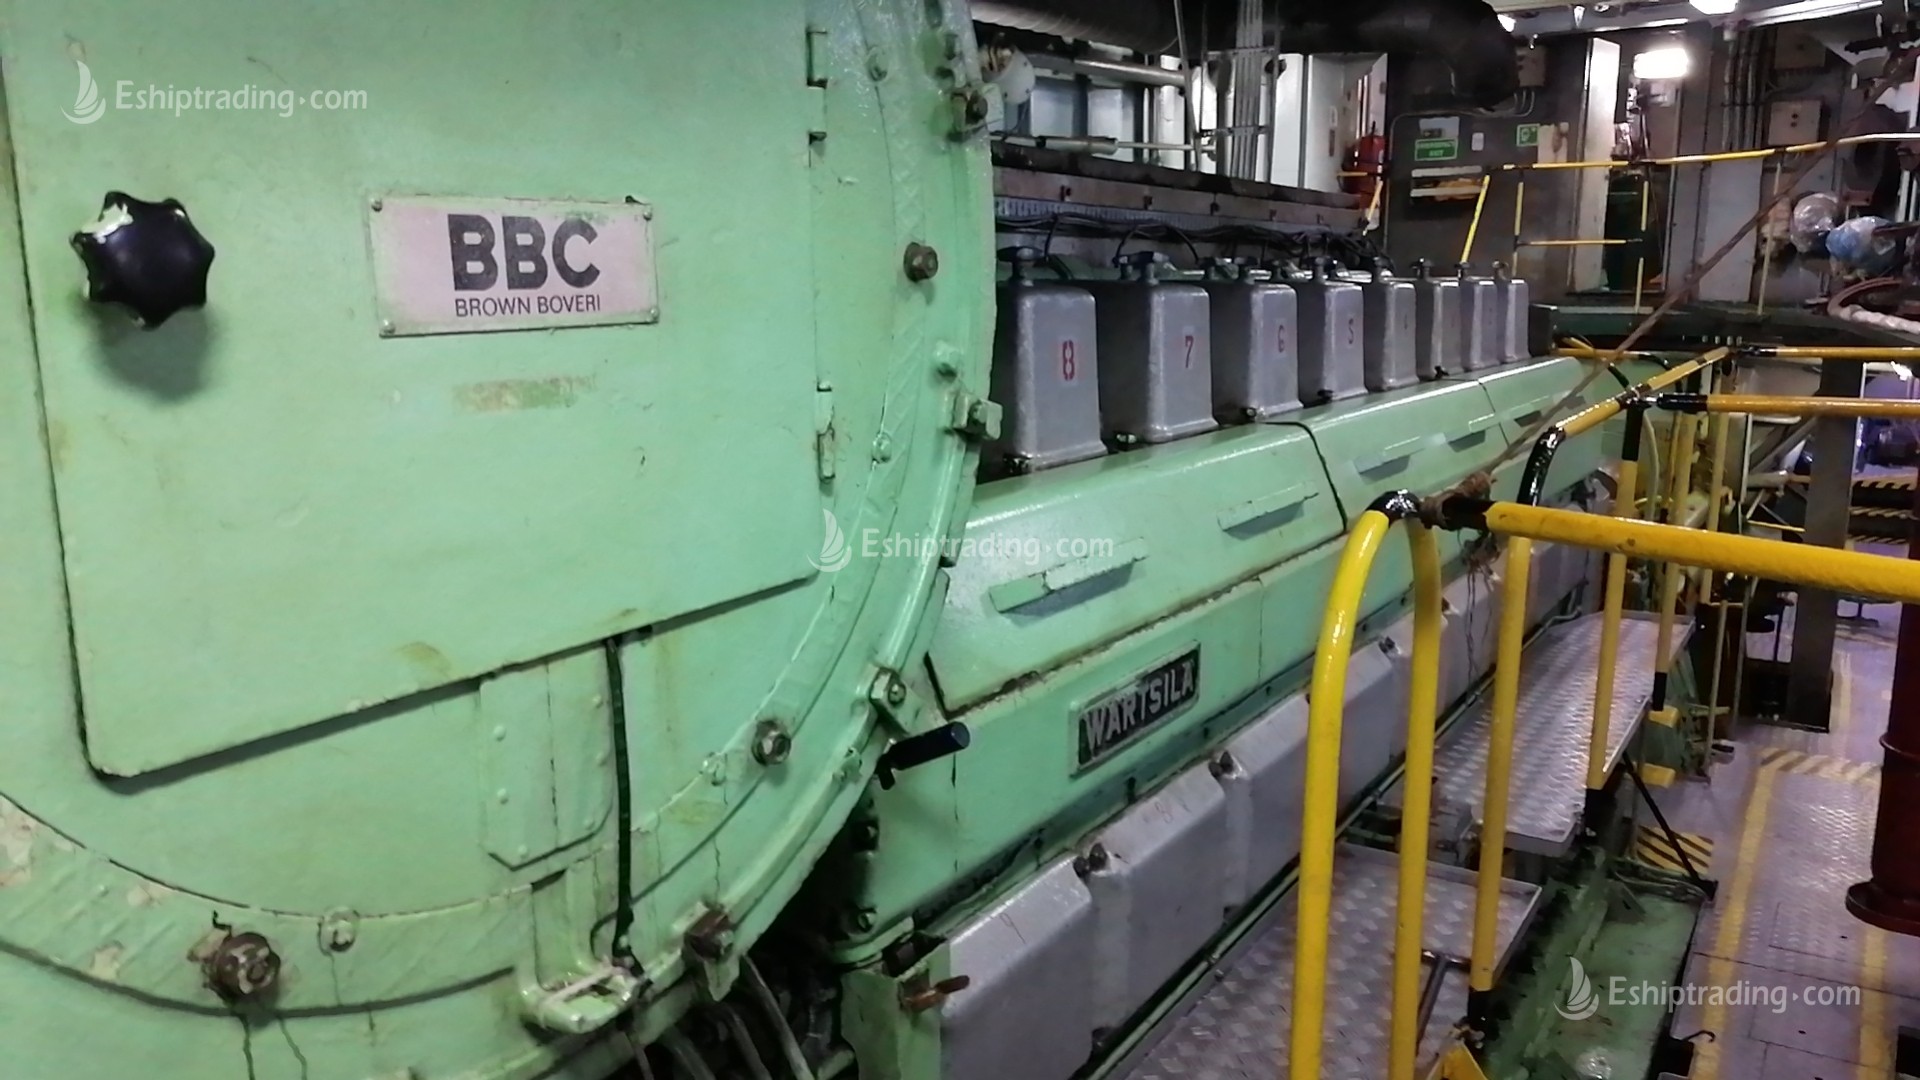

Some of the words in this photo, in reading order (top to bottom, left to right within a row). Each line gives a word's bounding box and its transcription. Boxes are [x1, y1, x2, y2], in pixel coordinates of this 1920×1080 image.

[447, 213, 601, 291] BBC
[455, 297, 532, 318] BROWN
[537, 294, 601, 315] BOVERI
[1062, 340, 1075, 381] 8
[1185, 335, 1194, 368] 7
